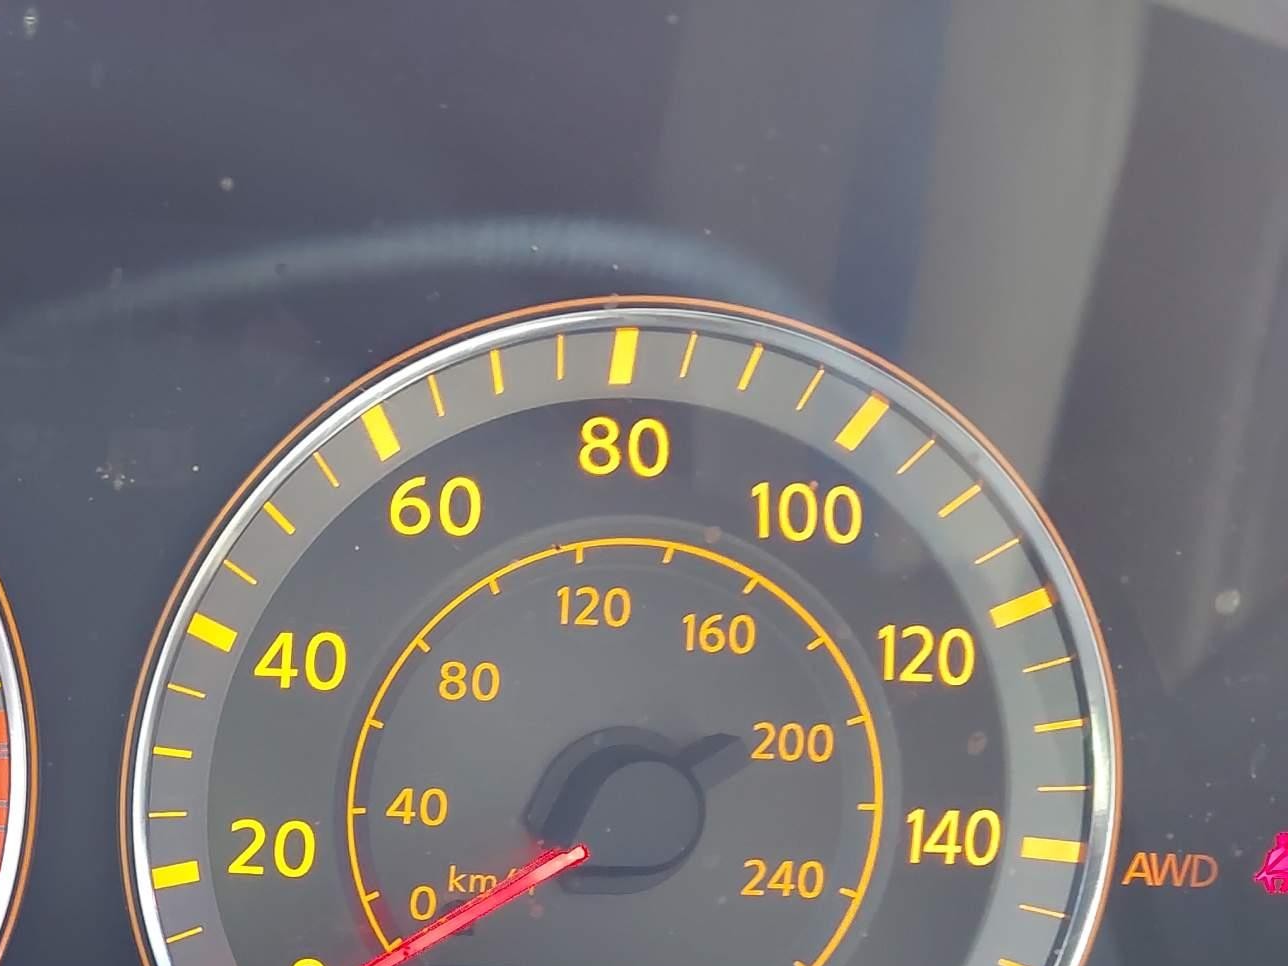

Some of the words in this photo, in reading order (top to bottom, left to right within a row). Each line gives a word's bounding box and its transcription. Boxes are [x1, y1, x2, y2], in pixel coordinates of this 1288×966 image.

[578, 416, 671, 478] 80
[389, 476, 482, 537] 60
[750, 481, 863, 545] 100
[555, 585, 631, 628] 120
[682, 614, 756, 655] 160
[877, 624, 975, 687] 120
[253, 631, 348, 691] 40
[438, 661, 501, 702] 80
[750, 721, 835, 763] 200
[385, 788, 448, 826] 40
[227, 818, 316, 878] 20
[906, 808, 1001, 866] 140
[740, 860, 825, 899] 240
[1120, 851, 1219, 888] AWD
[409, 886, 438, 921] 0
